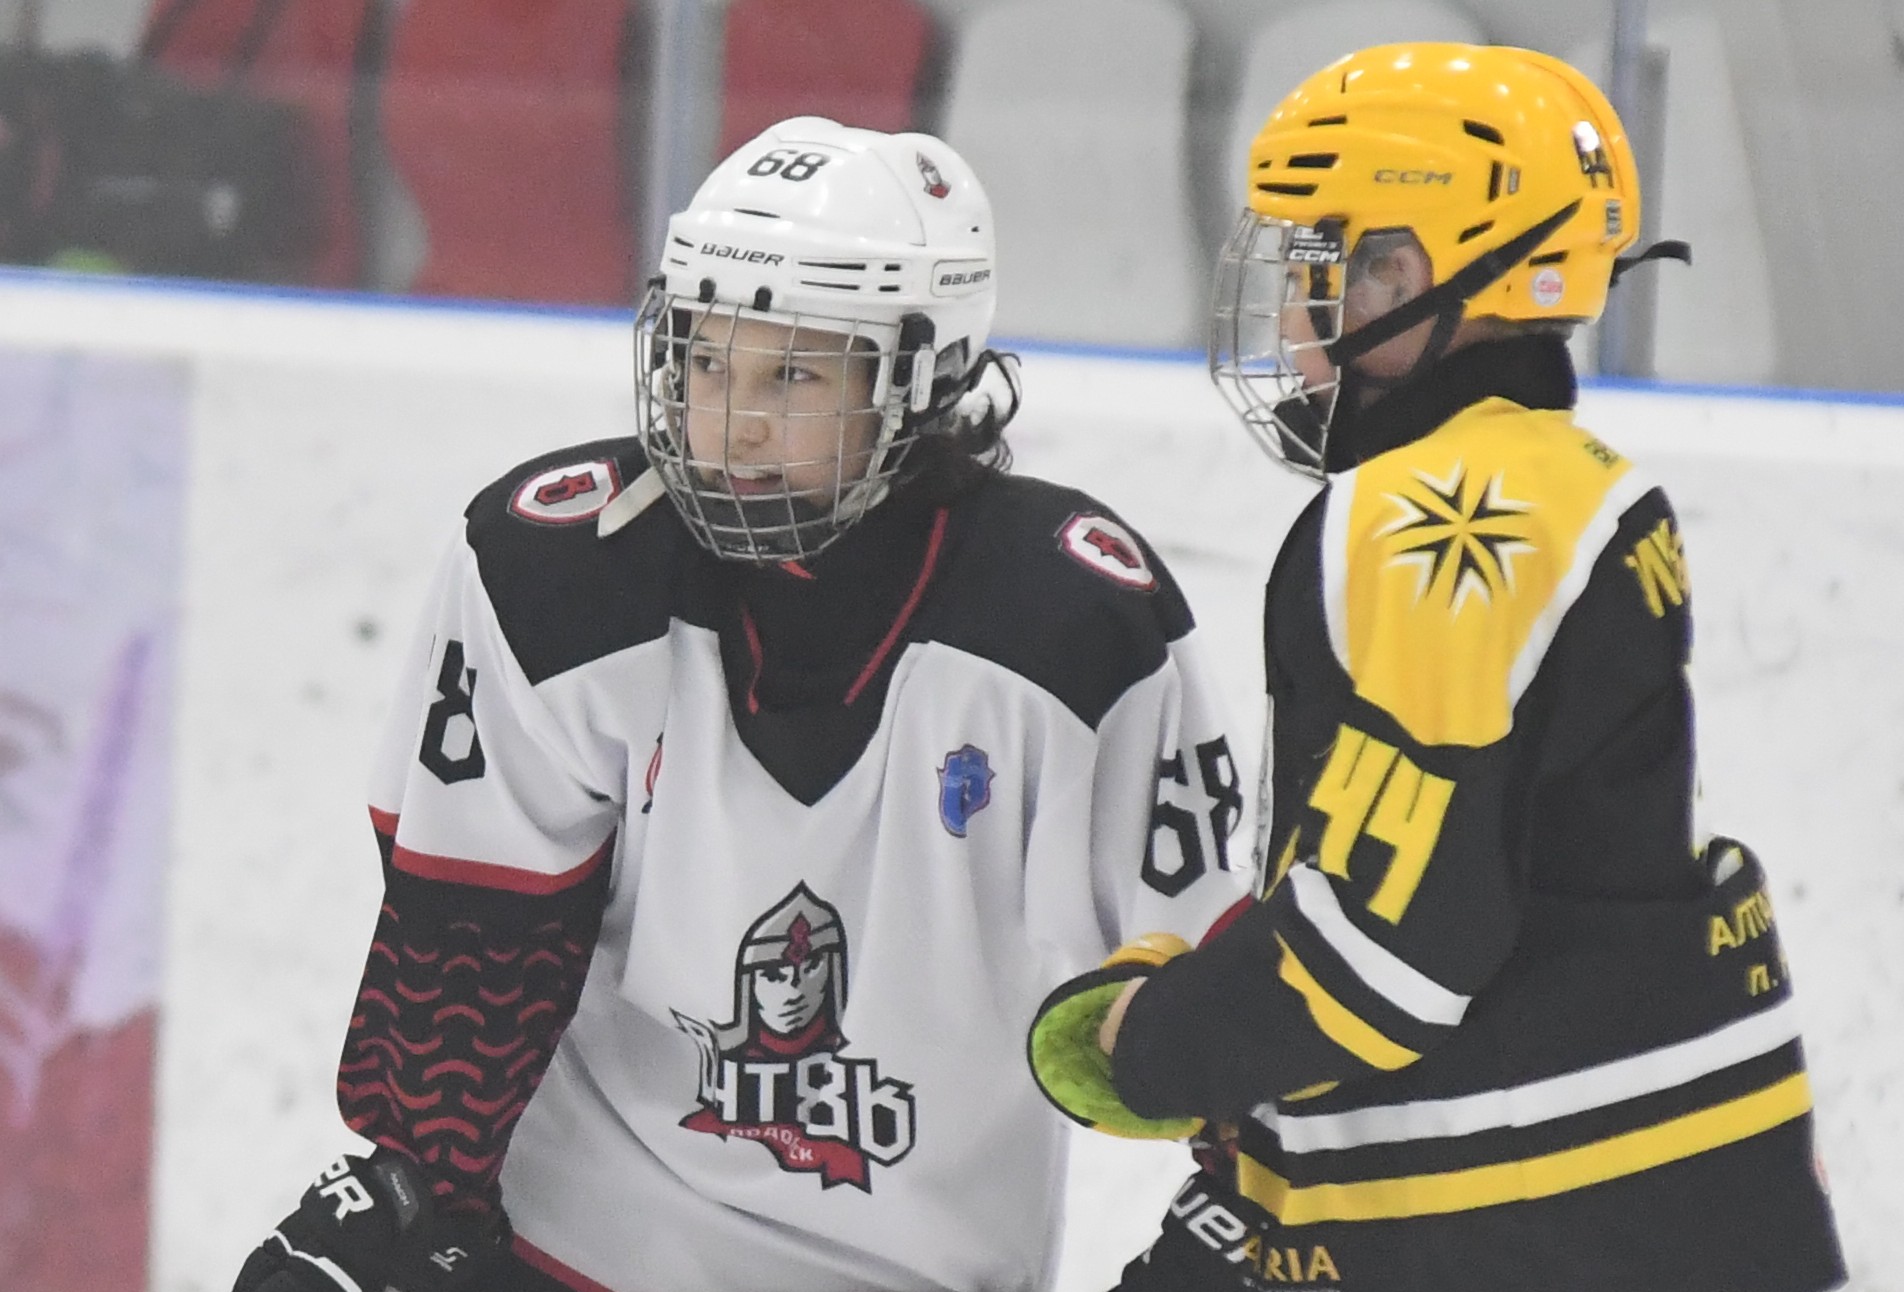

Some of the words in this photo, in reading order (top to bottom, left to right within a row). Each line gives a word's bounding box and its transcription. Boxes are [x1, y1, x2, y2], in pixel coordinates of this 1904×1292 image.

[747, 149, 831, 182] 68
[1374, 169, 1454, 185] CCM
[700, 242, 785, 267] BAUER
[1288, 248, 1340, 262] CCM
[1307, 722, 1457, 926] 44
